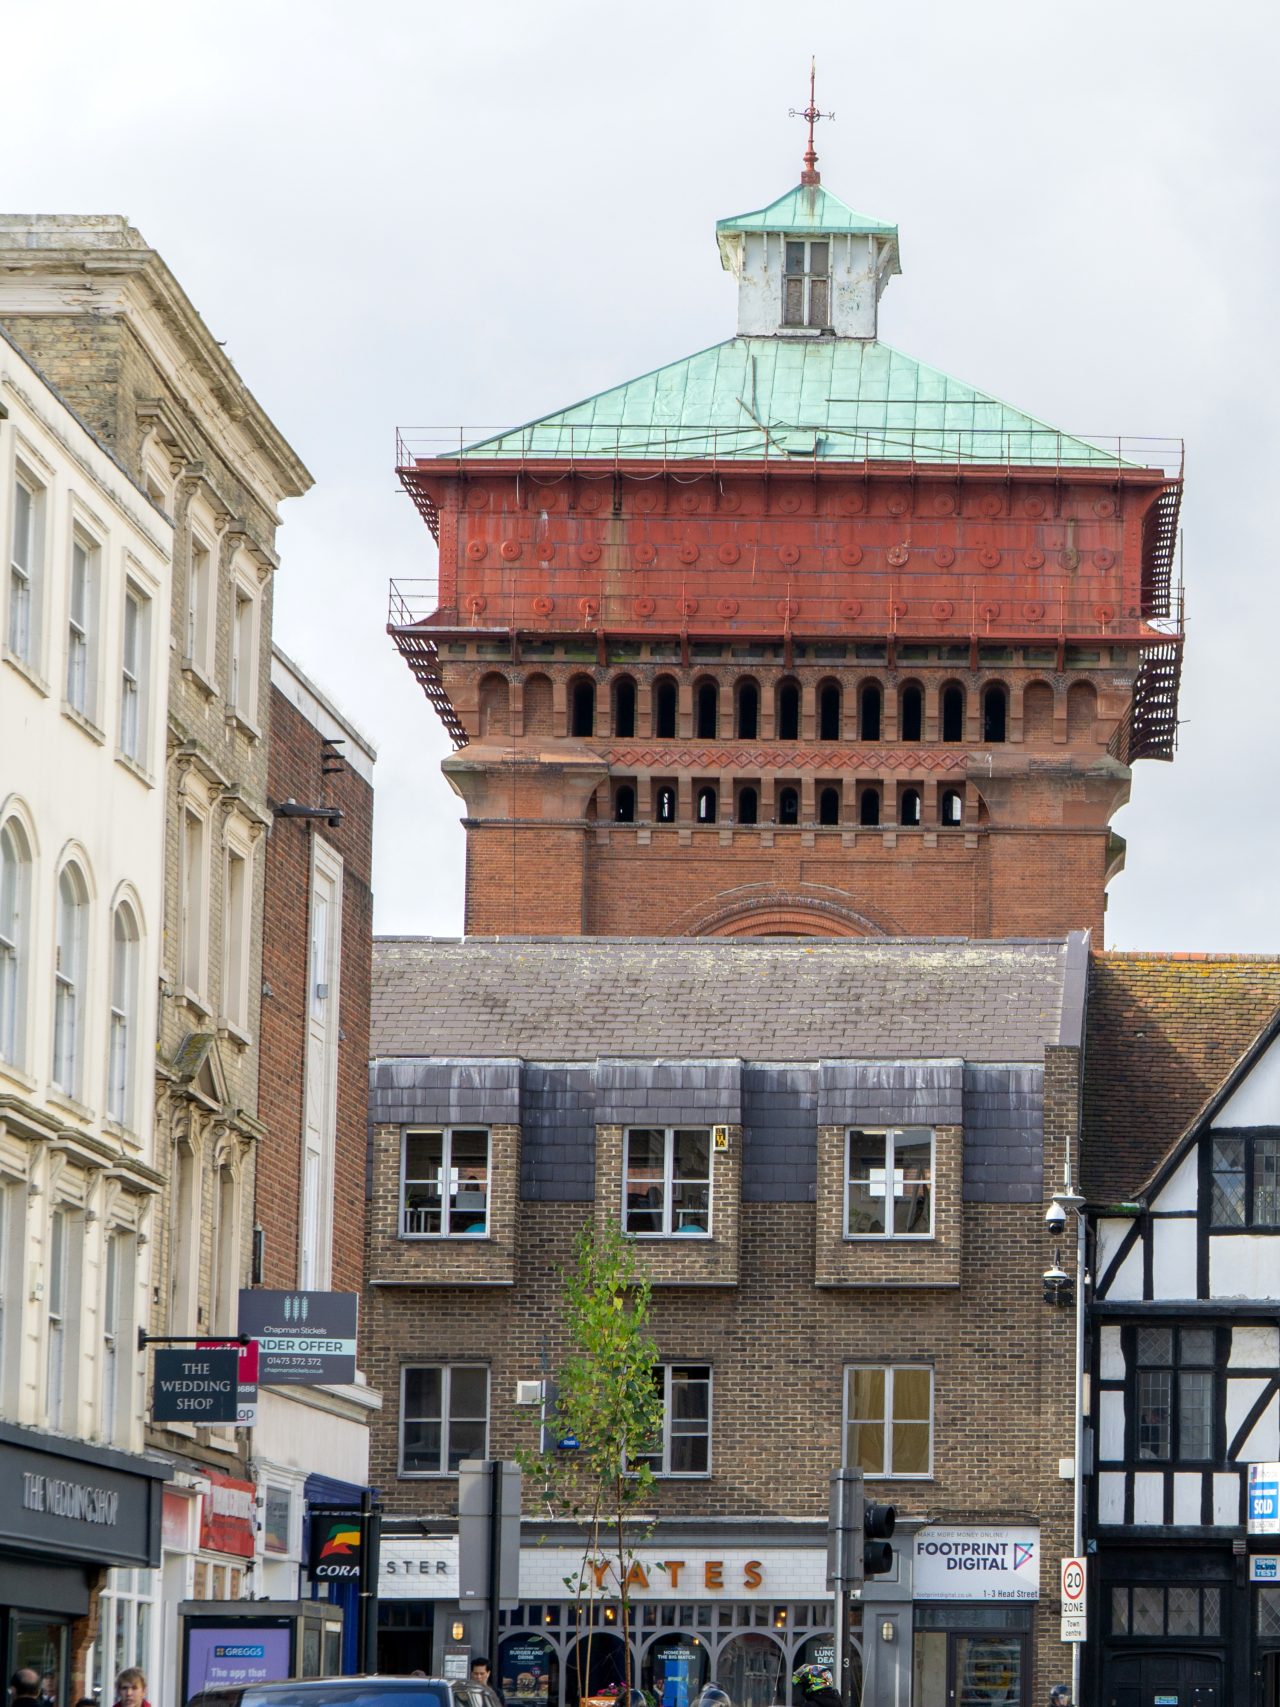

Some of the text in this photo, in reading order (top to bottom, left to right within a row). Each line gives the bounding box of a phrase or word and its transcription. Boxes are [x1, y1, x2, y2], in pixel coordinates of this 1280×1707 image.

[264, 1326, 327, 1336] Chapman Stickels
[259, 1340, 295, 1351] NDER
[299, 1341, 343, 1352] OFFER
[267, 1357, 290, 1365] 01473
[182, 1363, 210, 1375] THE
[161, 1381, 231, 1392] WEDDING
[176, 1399, 214, 1410] SHOP
[23, 1472, 118, 1526] THE WEDDING SHOP
[1254, 1499, 1273, 1514] SOLD
[917, 1542, 1008, 1556] FOOTPRINT
[386, 1561, 448, 1574] STER
[947, 1557, 1008, 1571] DIGITAL
[316, 1565, 360, 1577] CORA
[588, 1560, 763, 1590] YATES
[1067, 1572, 1082, 1588] 20
[997, 1590, 1015, 1598] Head
[1016, 1590, 1038, 1598] Street
[1063, 1602, 1084, 1612] ZONE
[1065, 1629, 1082, 1637] centre
[225, 1647, 262, 1656] GREGGS
[843, 1658, 850, 1668] 3
[211, 1667, 267, 1679] The app that
